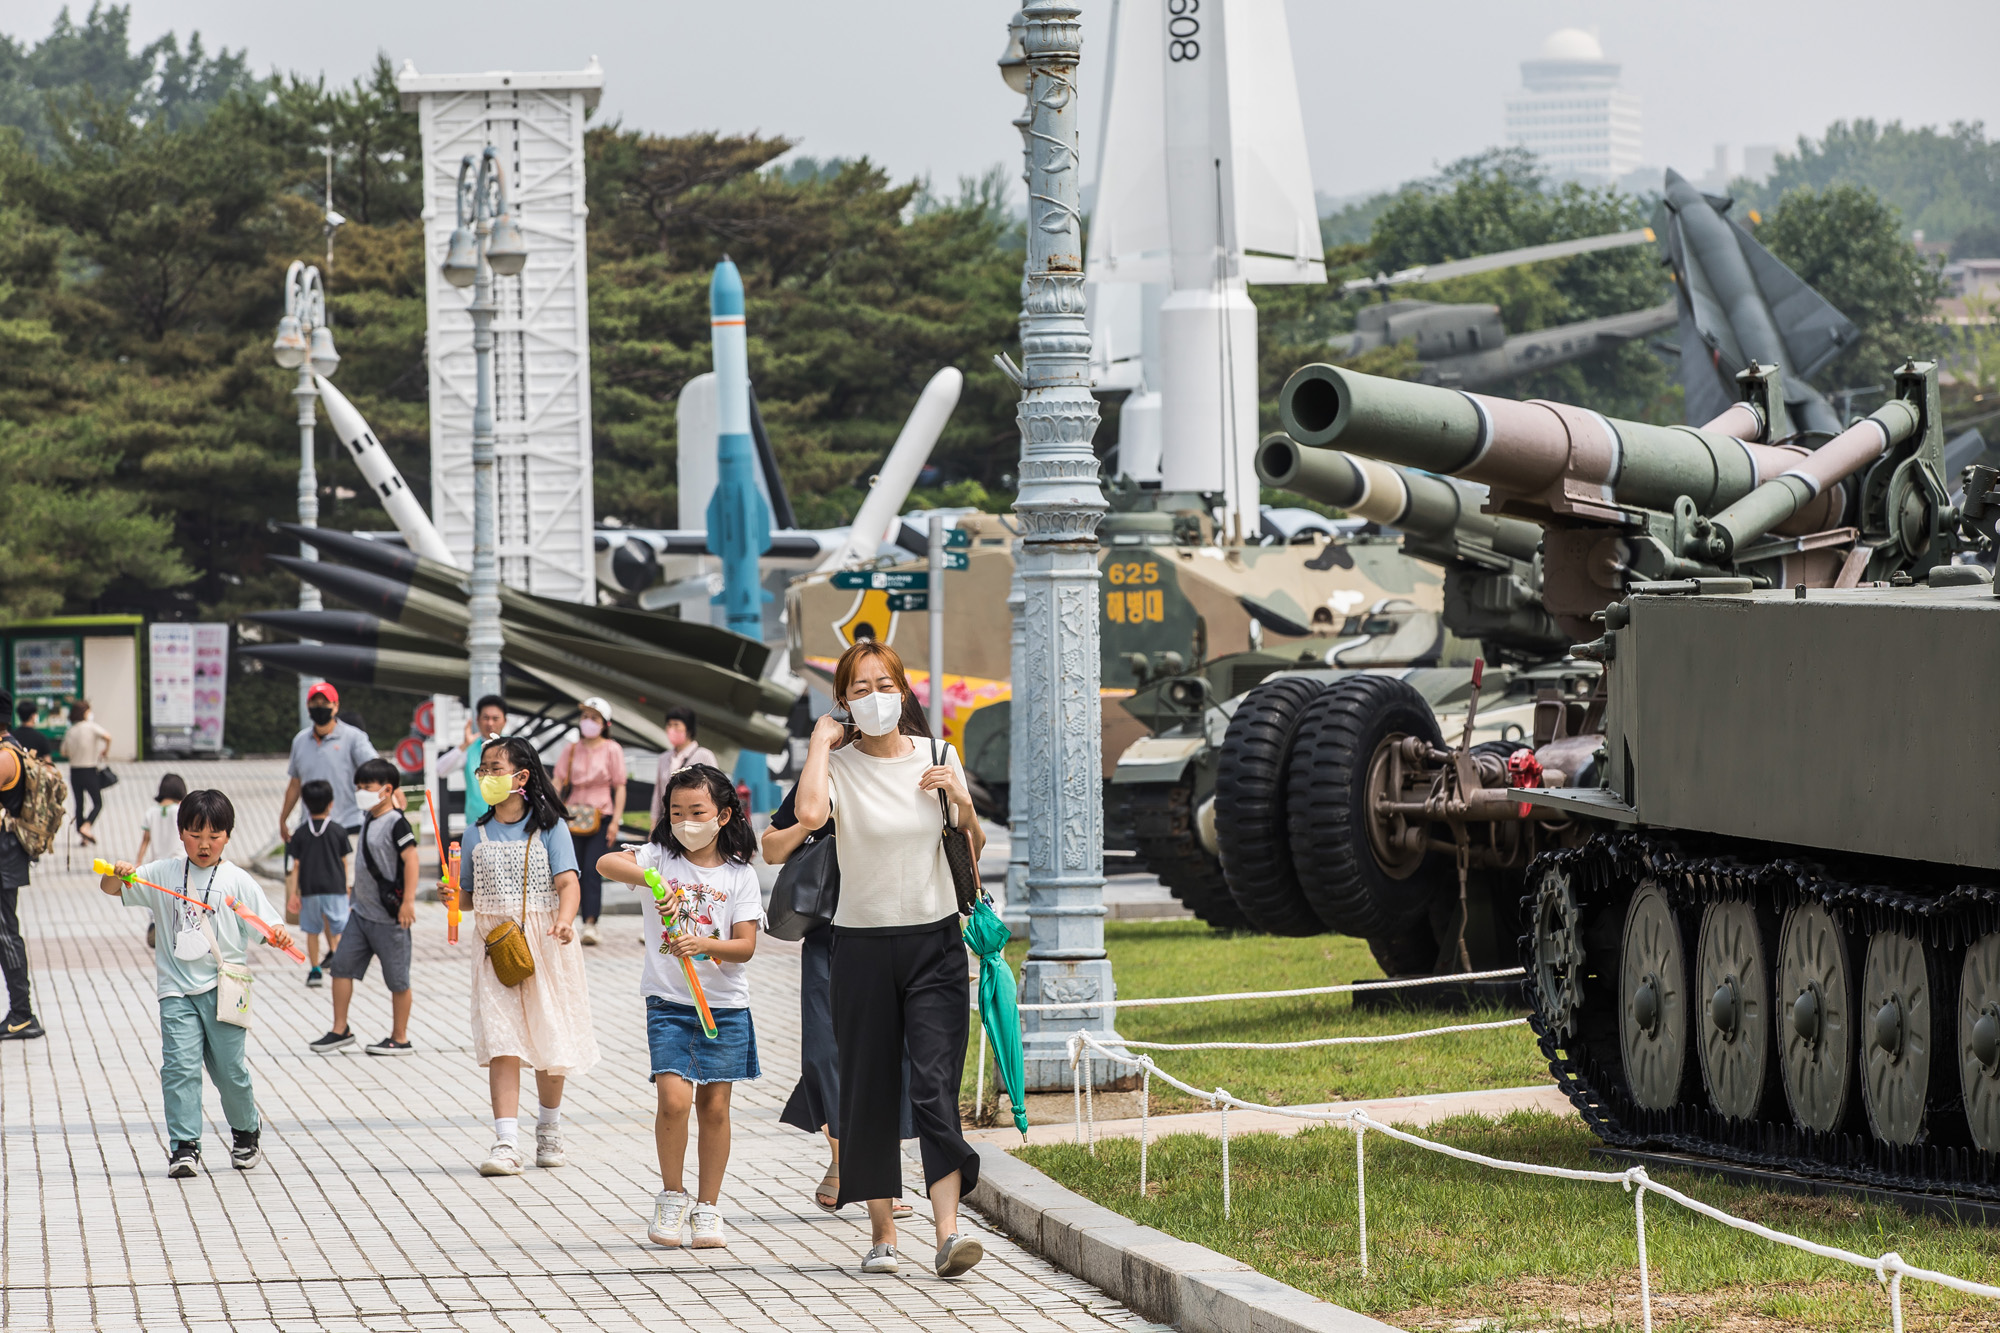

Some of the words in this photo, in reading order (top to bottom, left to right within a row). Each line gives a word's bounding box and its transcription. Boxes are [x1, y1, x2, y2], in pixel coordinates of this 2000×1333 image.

[1168, 0, 1200, 62] 608
[1108, 562, 1159, 585] 625
[1106, 589, 1164, 623] 해병대
[667, 877, 728, 902] Greetings
